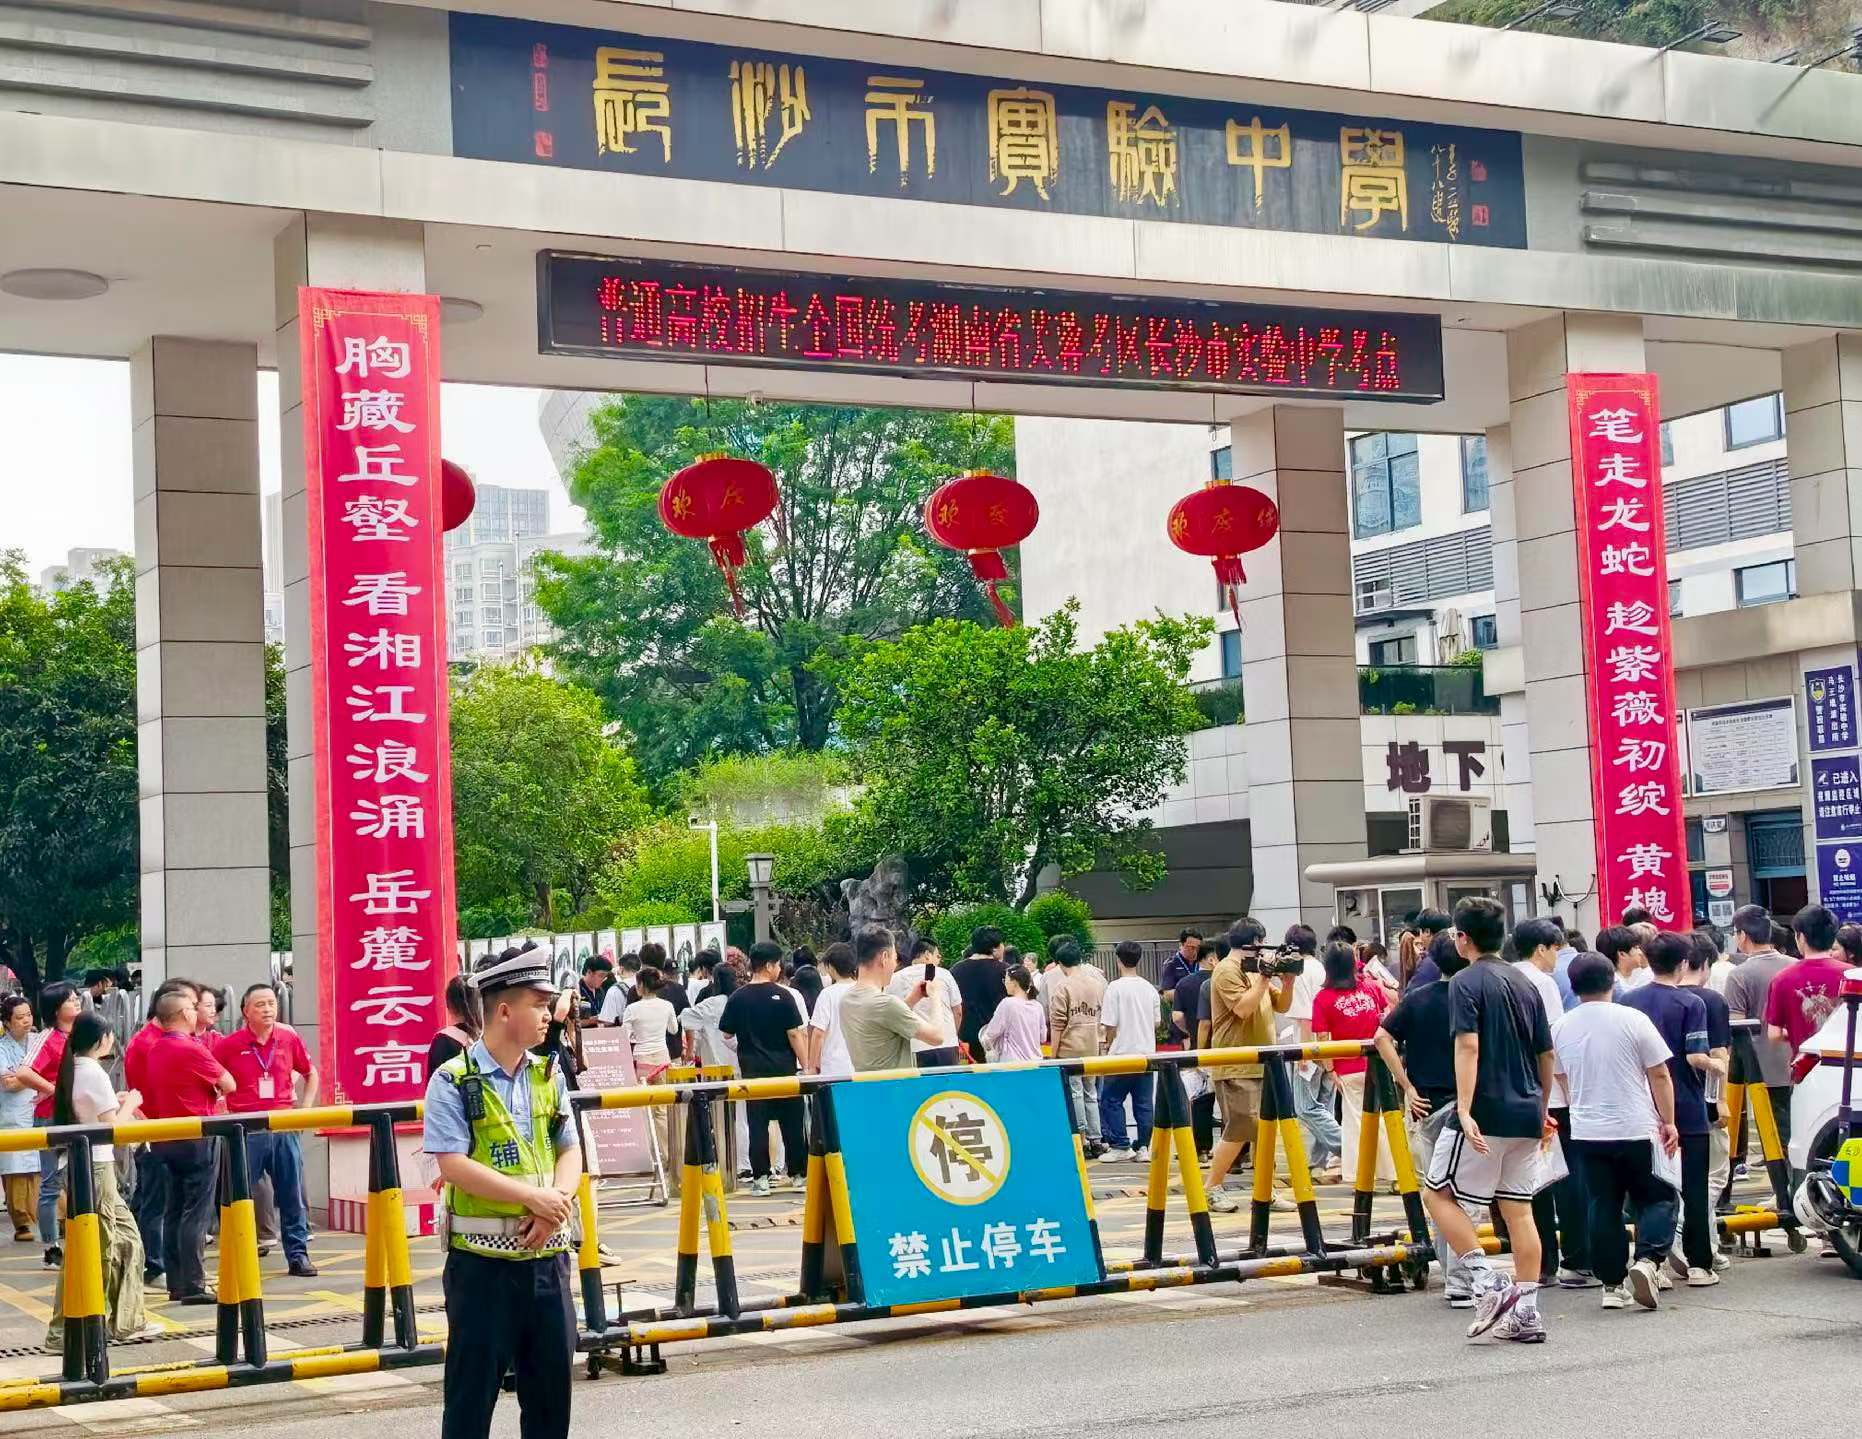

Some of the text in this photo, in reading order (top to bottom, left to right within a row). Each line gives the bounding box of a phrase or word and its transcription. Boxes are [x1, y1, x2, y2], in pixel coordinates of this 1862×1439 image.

[1588, 407, 1655, 577] 笔走龙蛇
[336, 336, 434, 1087] 胸藏丘壑 看湘江浪涌 岳麓云高
[1604, 600, 1671, 816] 趁紫薇初绽
[1386, 741, 1505, 793] 地下
[489, 1138, 520, 1168] 辅
[929, 1112, 993, 1184] 停
[888, 1217, 1067, 1280] 禁止停车
